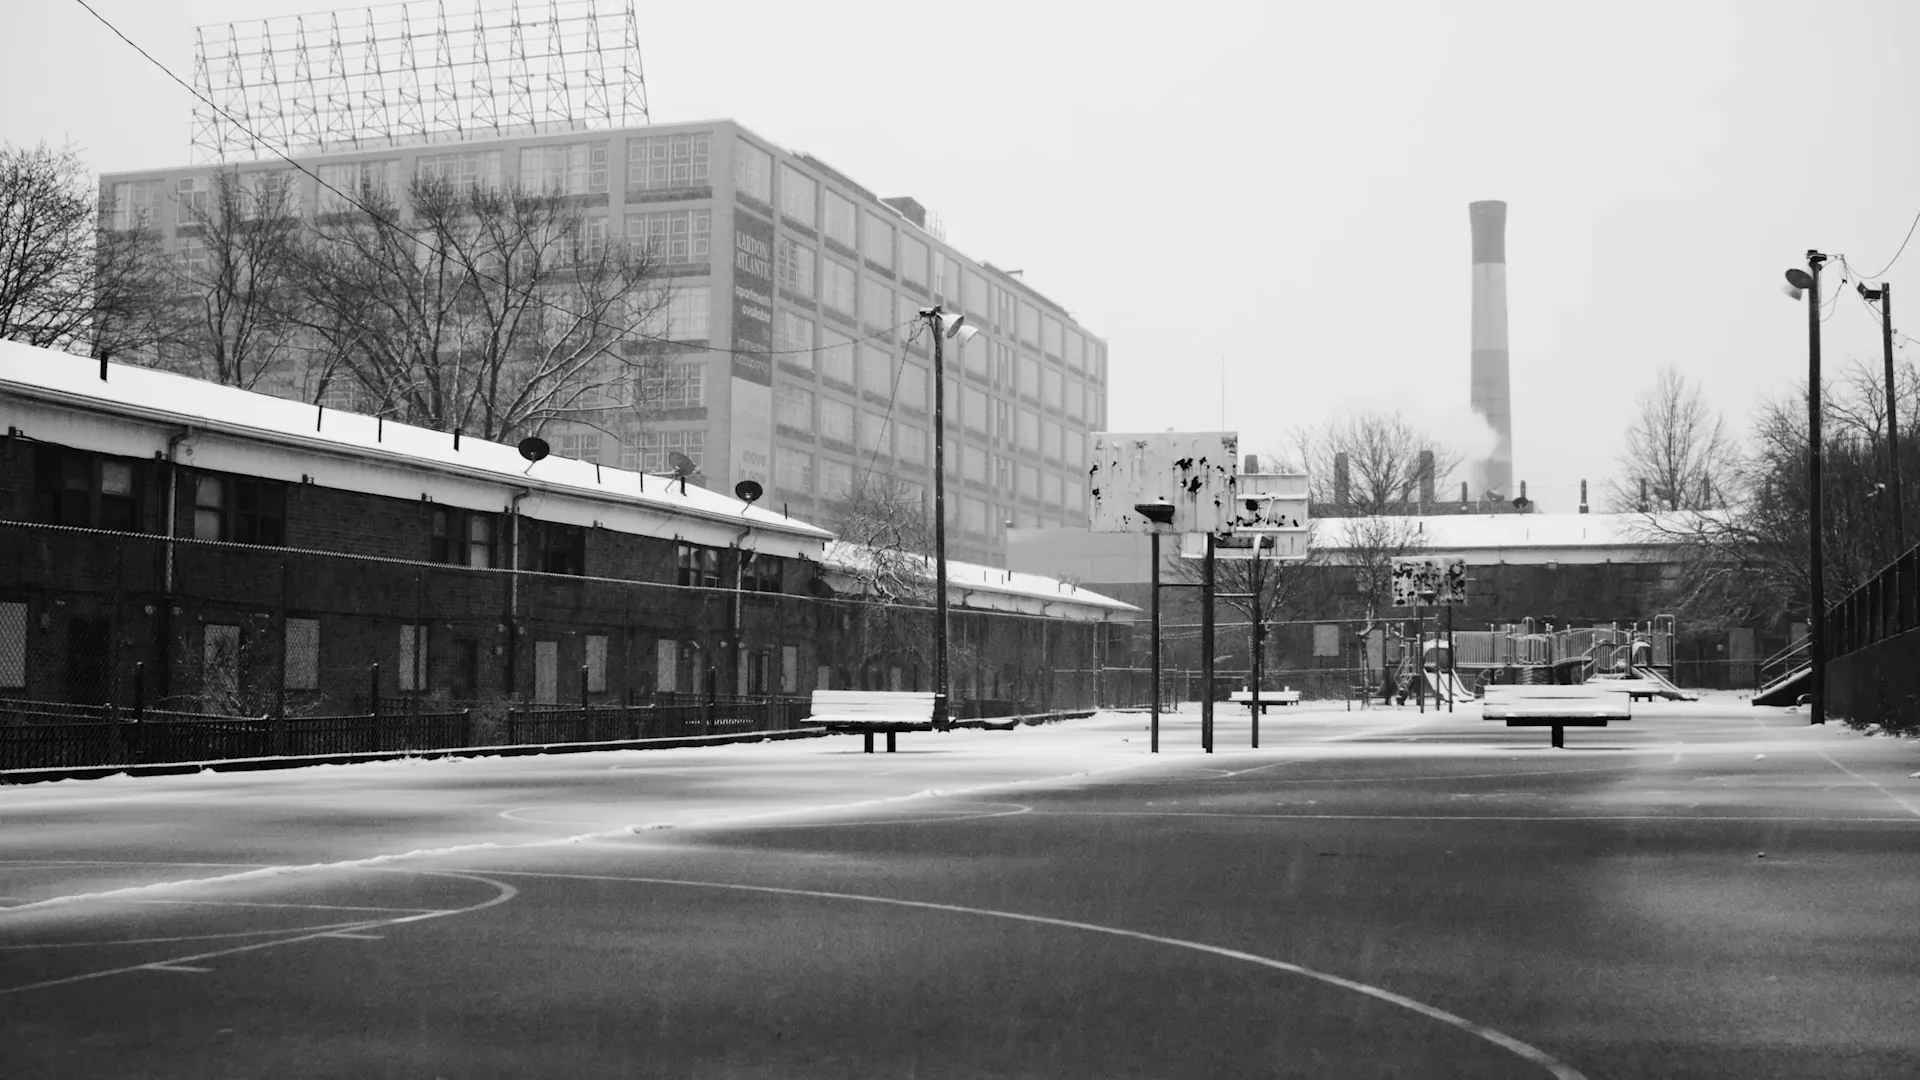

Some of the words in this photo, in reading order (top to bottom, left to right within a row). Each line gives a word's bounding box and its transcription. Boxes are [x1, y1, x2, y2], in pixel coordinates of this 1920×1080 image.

[736, 250, 771, 281] ATLANTIC
[735, 285, 771, 307] apartments
[742, 304, 771, 323] available
[742, 450, 766, 467] move
